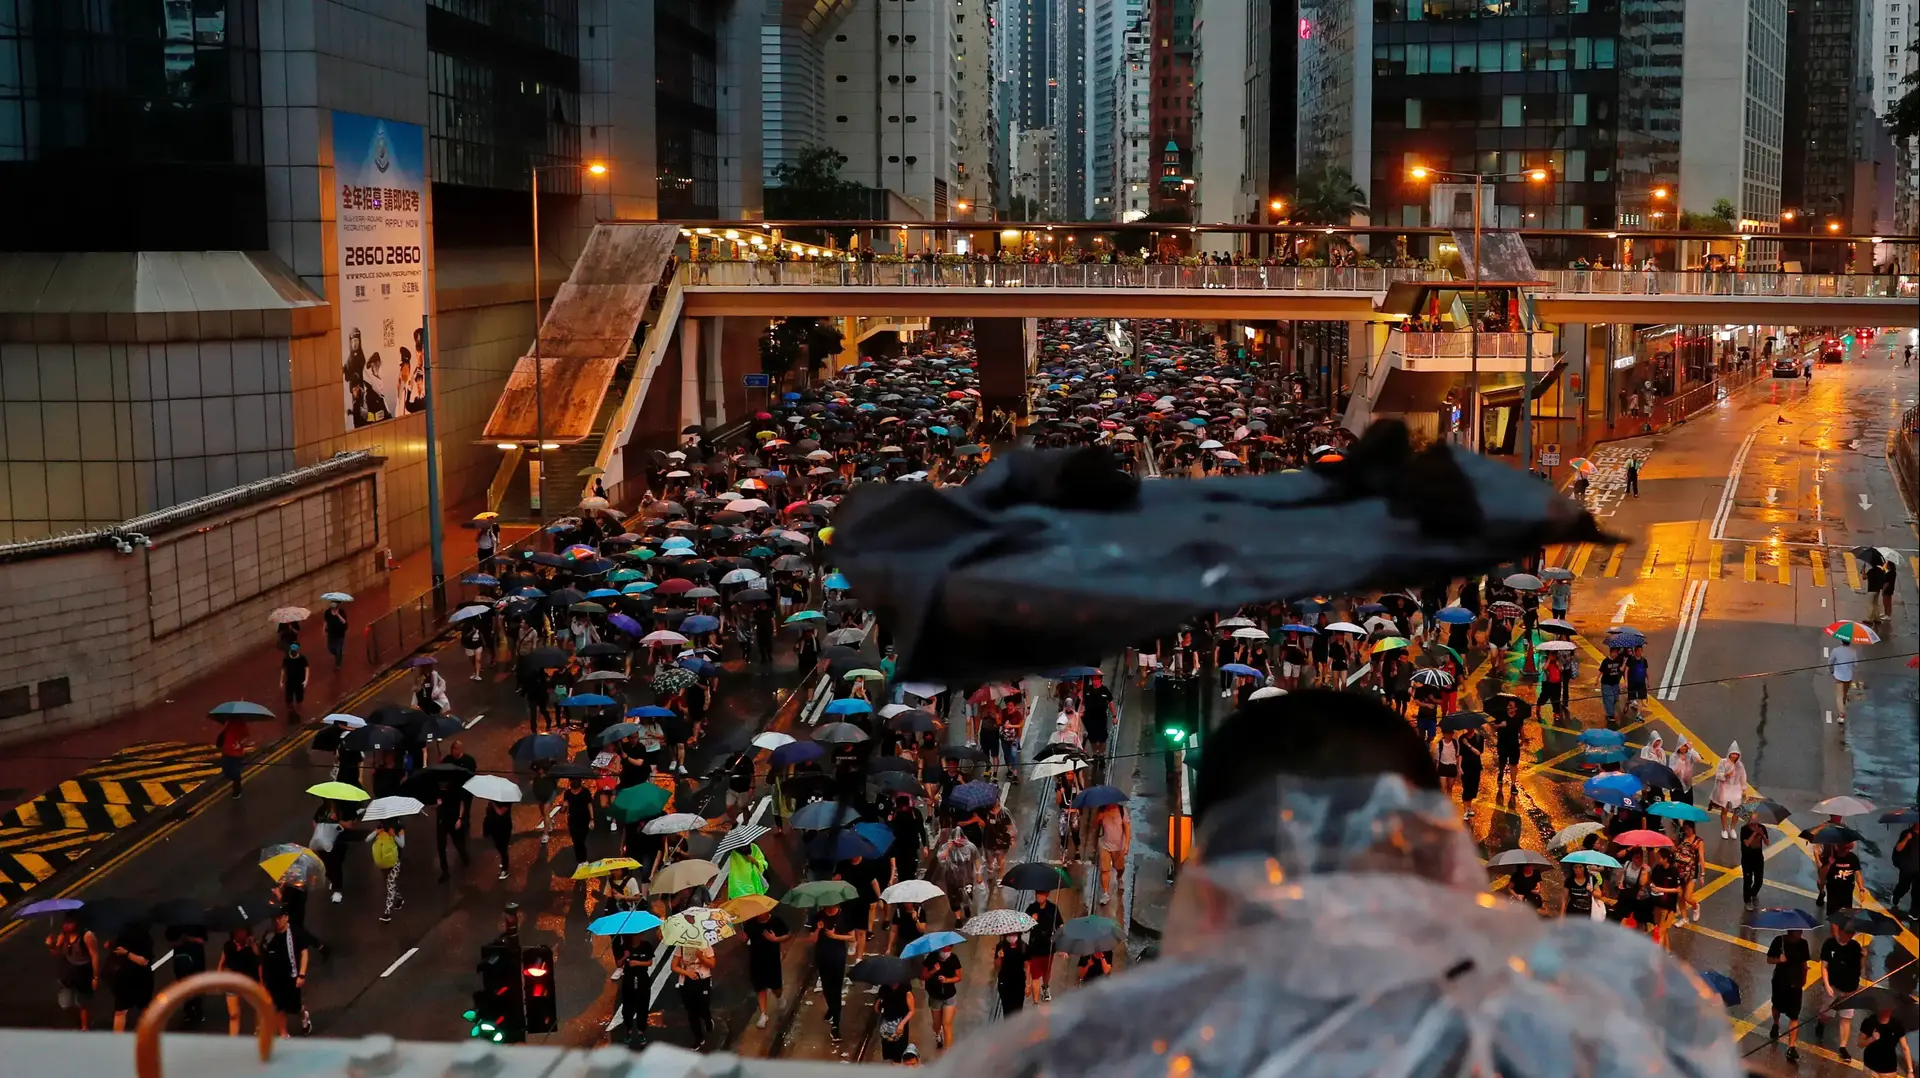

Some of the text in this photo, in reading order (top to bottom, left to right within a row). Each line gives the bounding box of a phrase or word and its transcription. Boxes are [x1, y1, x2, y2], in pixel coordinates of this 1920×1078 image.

[342, 185, 419, 212] 全年招募 請即投考
[343, 224, 377, 232] RECRUITMENT
[385, 218, 419, 228] APPLY NOW
[345, 246, 420, 266] 2860 2860
